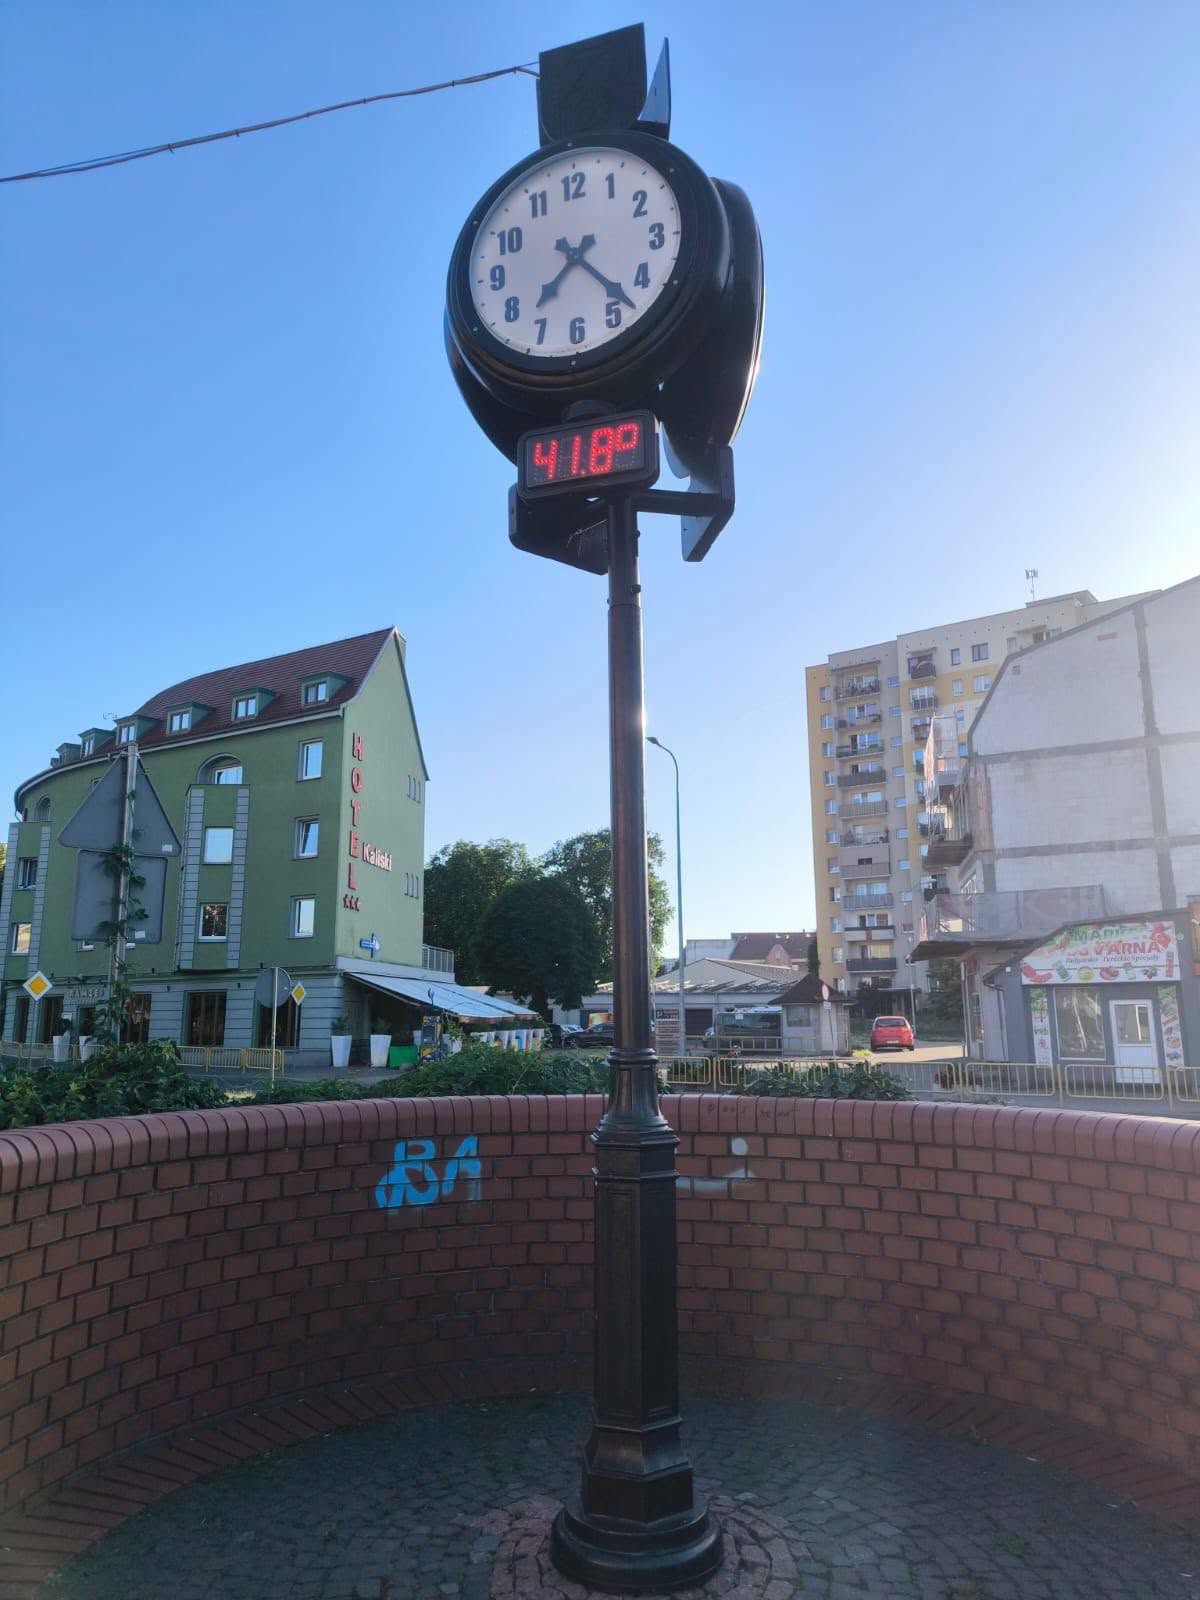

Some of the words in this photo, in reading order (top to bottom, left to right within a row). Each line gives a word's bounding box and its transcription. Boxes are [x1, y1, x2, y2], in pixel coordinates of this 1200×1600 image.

[561, 172, 586, 201] 12
[605, 173, 616, 199] 1
[529, 190, 548, 218] 11
[632, 190, 648, 218] 2
[497, 227, 523, 255] 10
[649, 222, 665, 250] 3
[490, 265, 506, 291] 9
[633, 262, 651, 289] 4
[504, 296, 520, 323] 8
[605, 300, 622, 328] 5
[534, 318, 548, 345] 7
[569, 317, 586, 344] 6
[348, 732, 363, 889] HOTEL
[362, 842, 392, 872] Kaliski
[1094, 941, 1161, 956] VARNA
